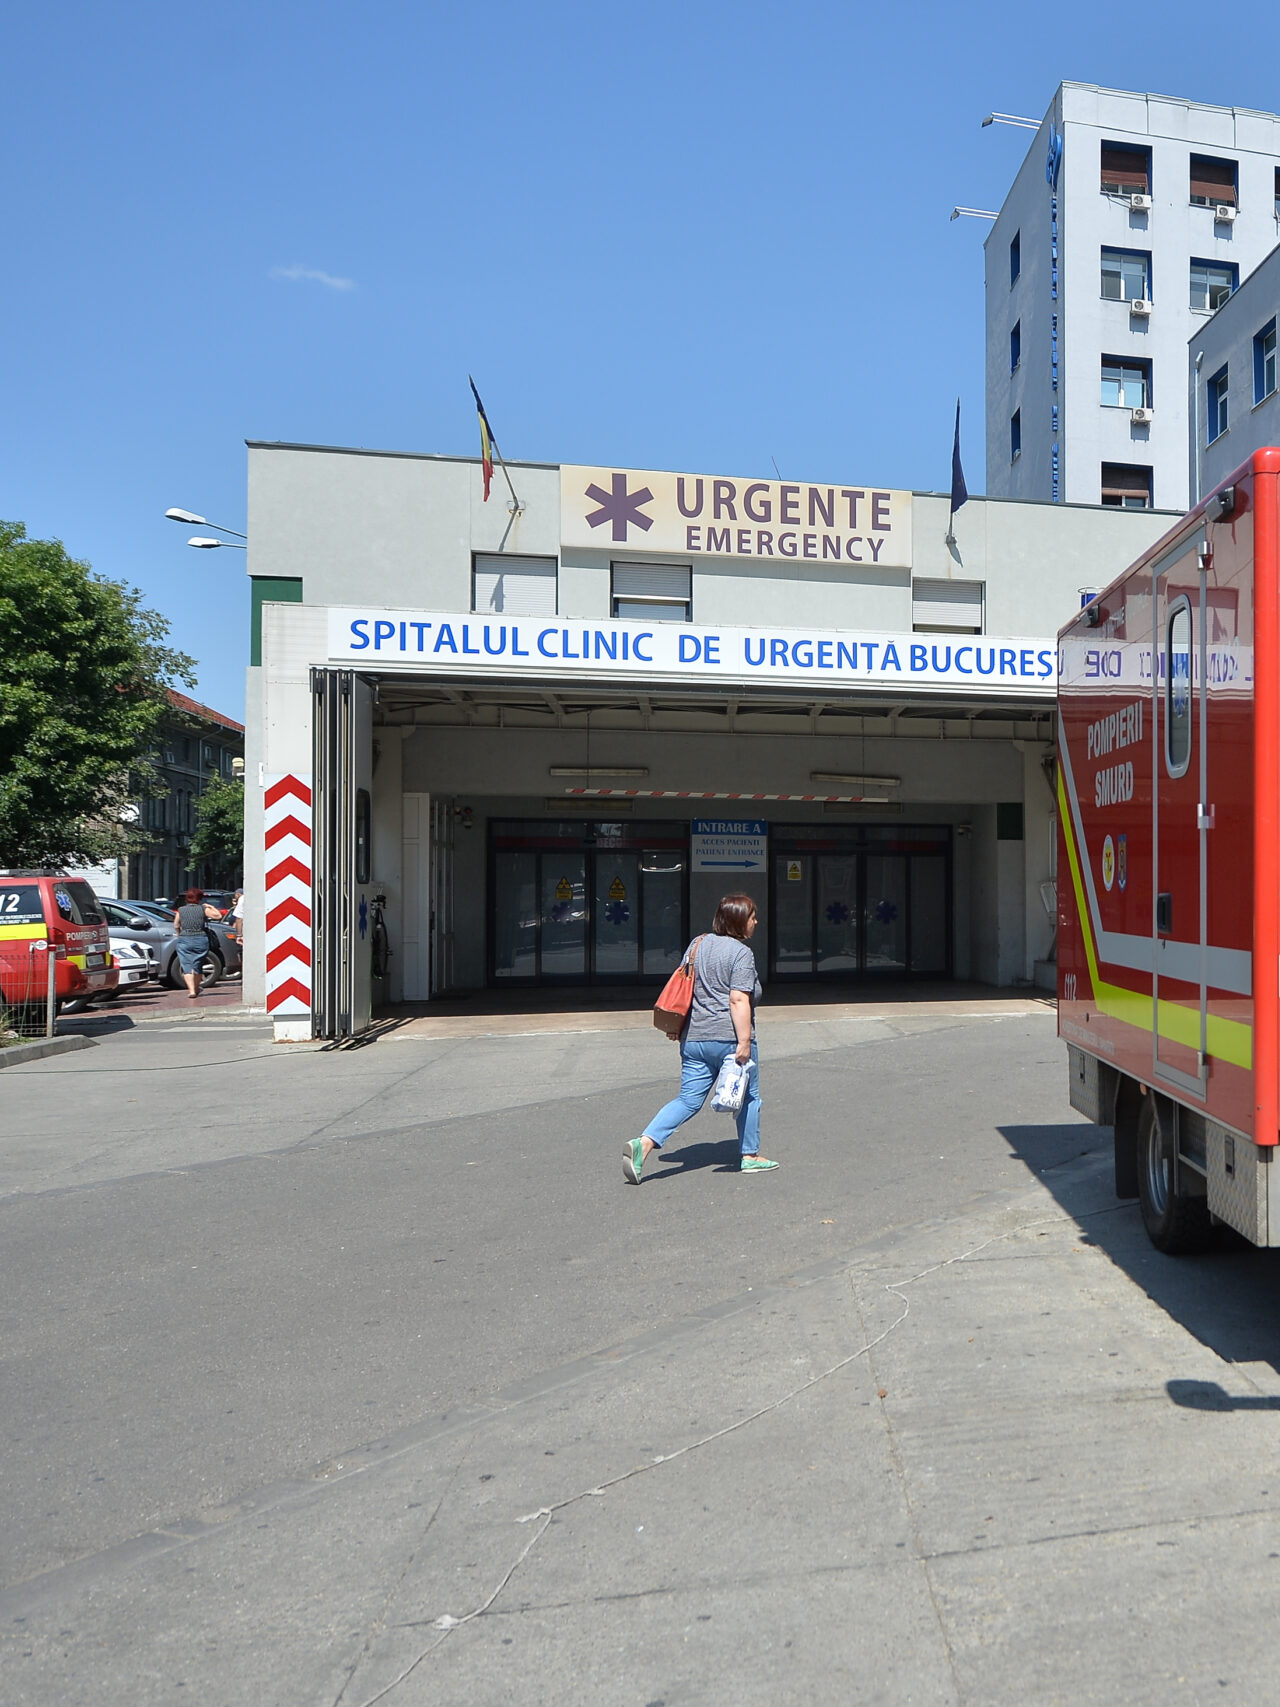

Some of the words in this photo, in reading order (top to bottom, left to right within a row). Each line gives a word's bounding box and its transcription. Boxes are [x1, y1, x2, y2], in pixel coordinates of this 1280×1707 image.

[676, 476, 891, 532] URGENTE
[686, 525, 885, 562] EMERGENCY
[349, 619, 529, 656] SPITALUL
[536, 628, 654, 662] CLINIC
[678, 634, 721, 664] DE
[909, 644, 1058, 681] BUCUREȘ
[1087, 700, 1143, 760] POMPIERII
[1095, 761, 1134, 808] SMURD
[697, 822, 750, 834] INTRARE
[752, 823, 761, 834] A
[695, 848, 726, 856] PATIENT
[728, 848, 765, 856] ENTRANCE
